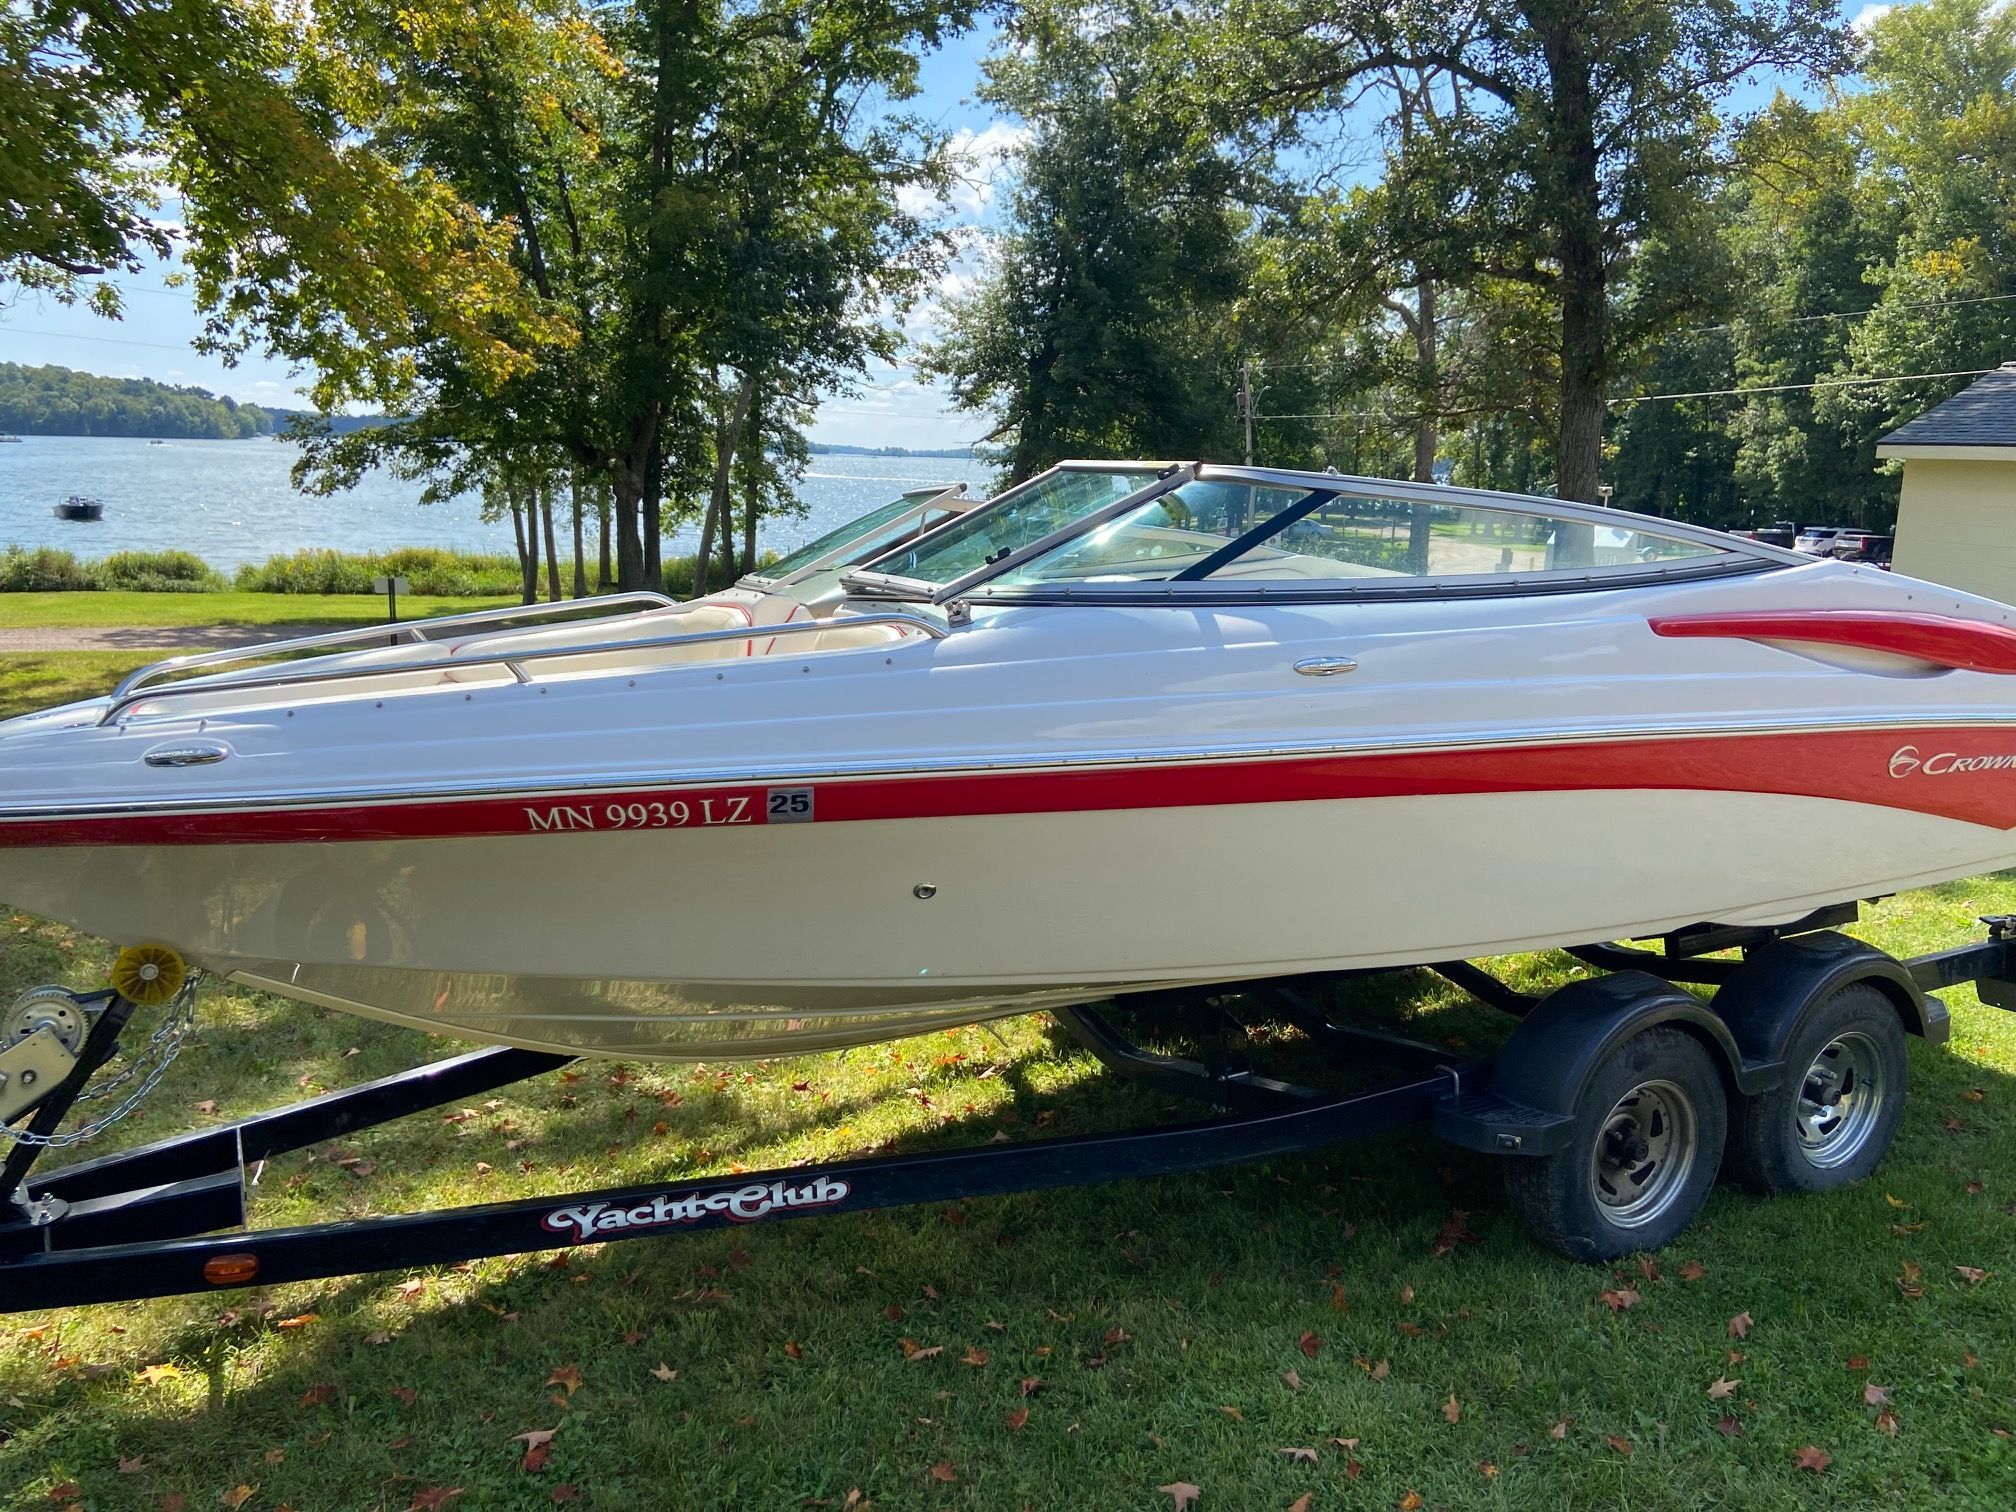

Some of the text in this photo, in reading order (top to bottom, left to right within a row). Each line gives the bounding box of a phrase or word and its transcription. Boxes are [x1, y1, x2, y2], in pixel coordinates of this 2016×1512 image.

[523, 796, 752, 831] MN 9939 LZ
[769, 794, 810, 814] 25
